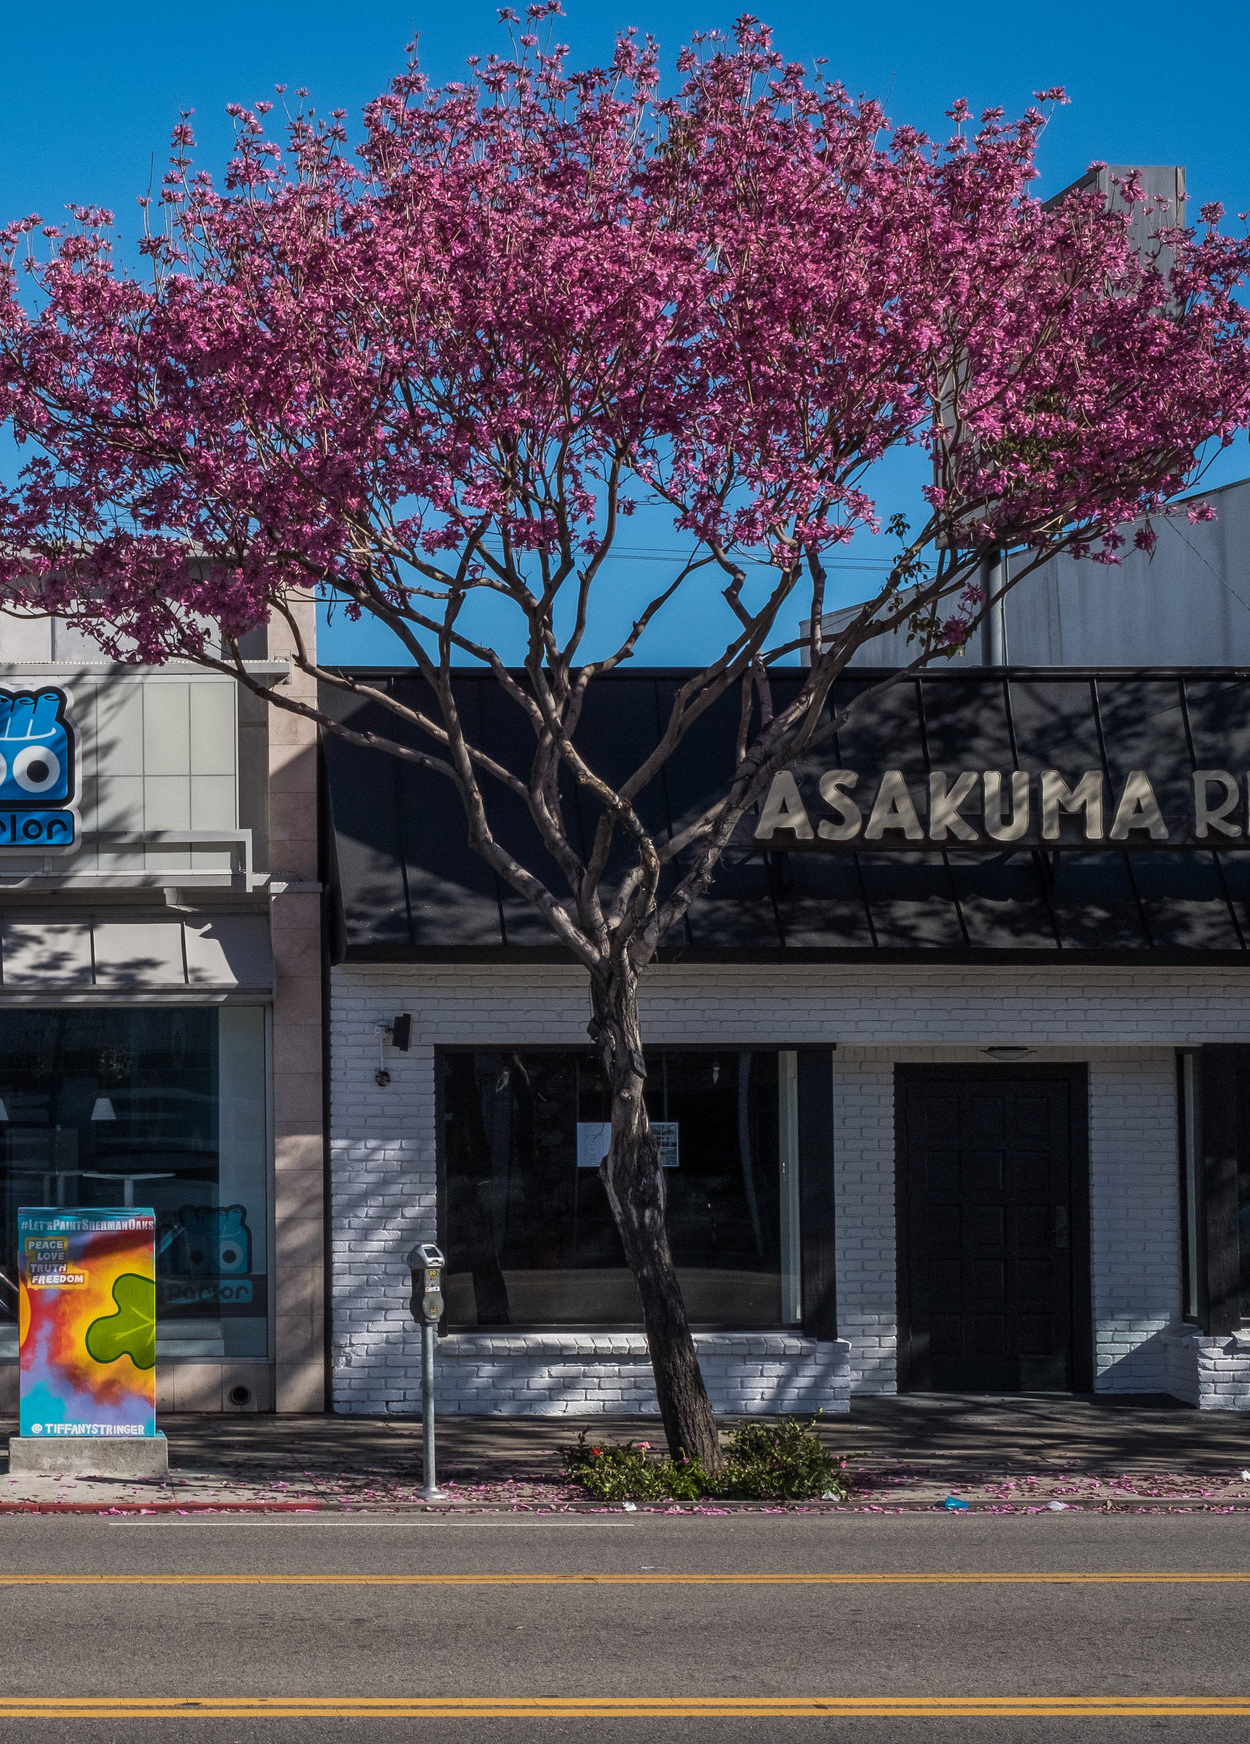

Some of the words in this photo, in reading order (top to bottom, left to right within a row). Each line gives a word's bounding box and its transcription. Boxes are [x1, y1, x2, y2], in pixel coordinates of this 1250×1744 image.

[754, 769, 1170, 841] ASAKUMA
[1193, 770, 1250, 839] R
[28, 1240, 64, 1250] PEACE
[37, 1252, 65, 1261] LOVE
[30, 1263, 67, 1273] TRUTH
[32, 1274, 84, 1285] FREEDOM
